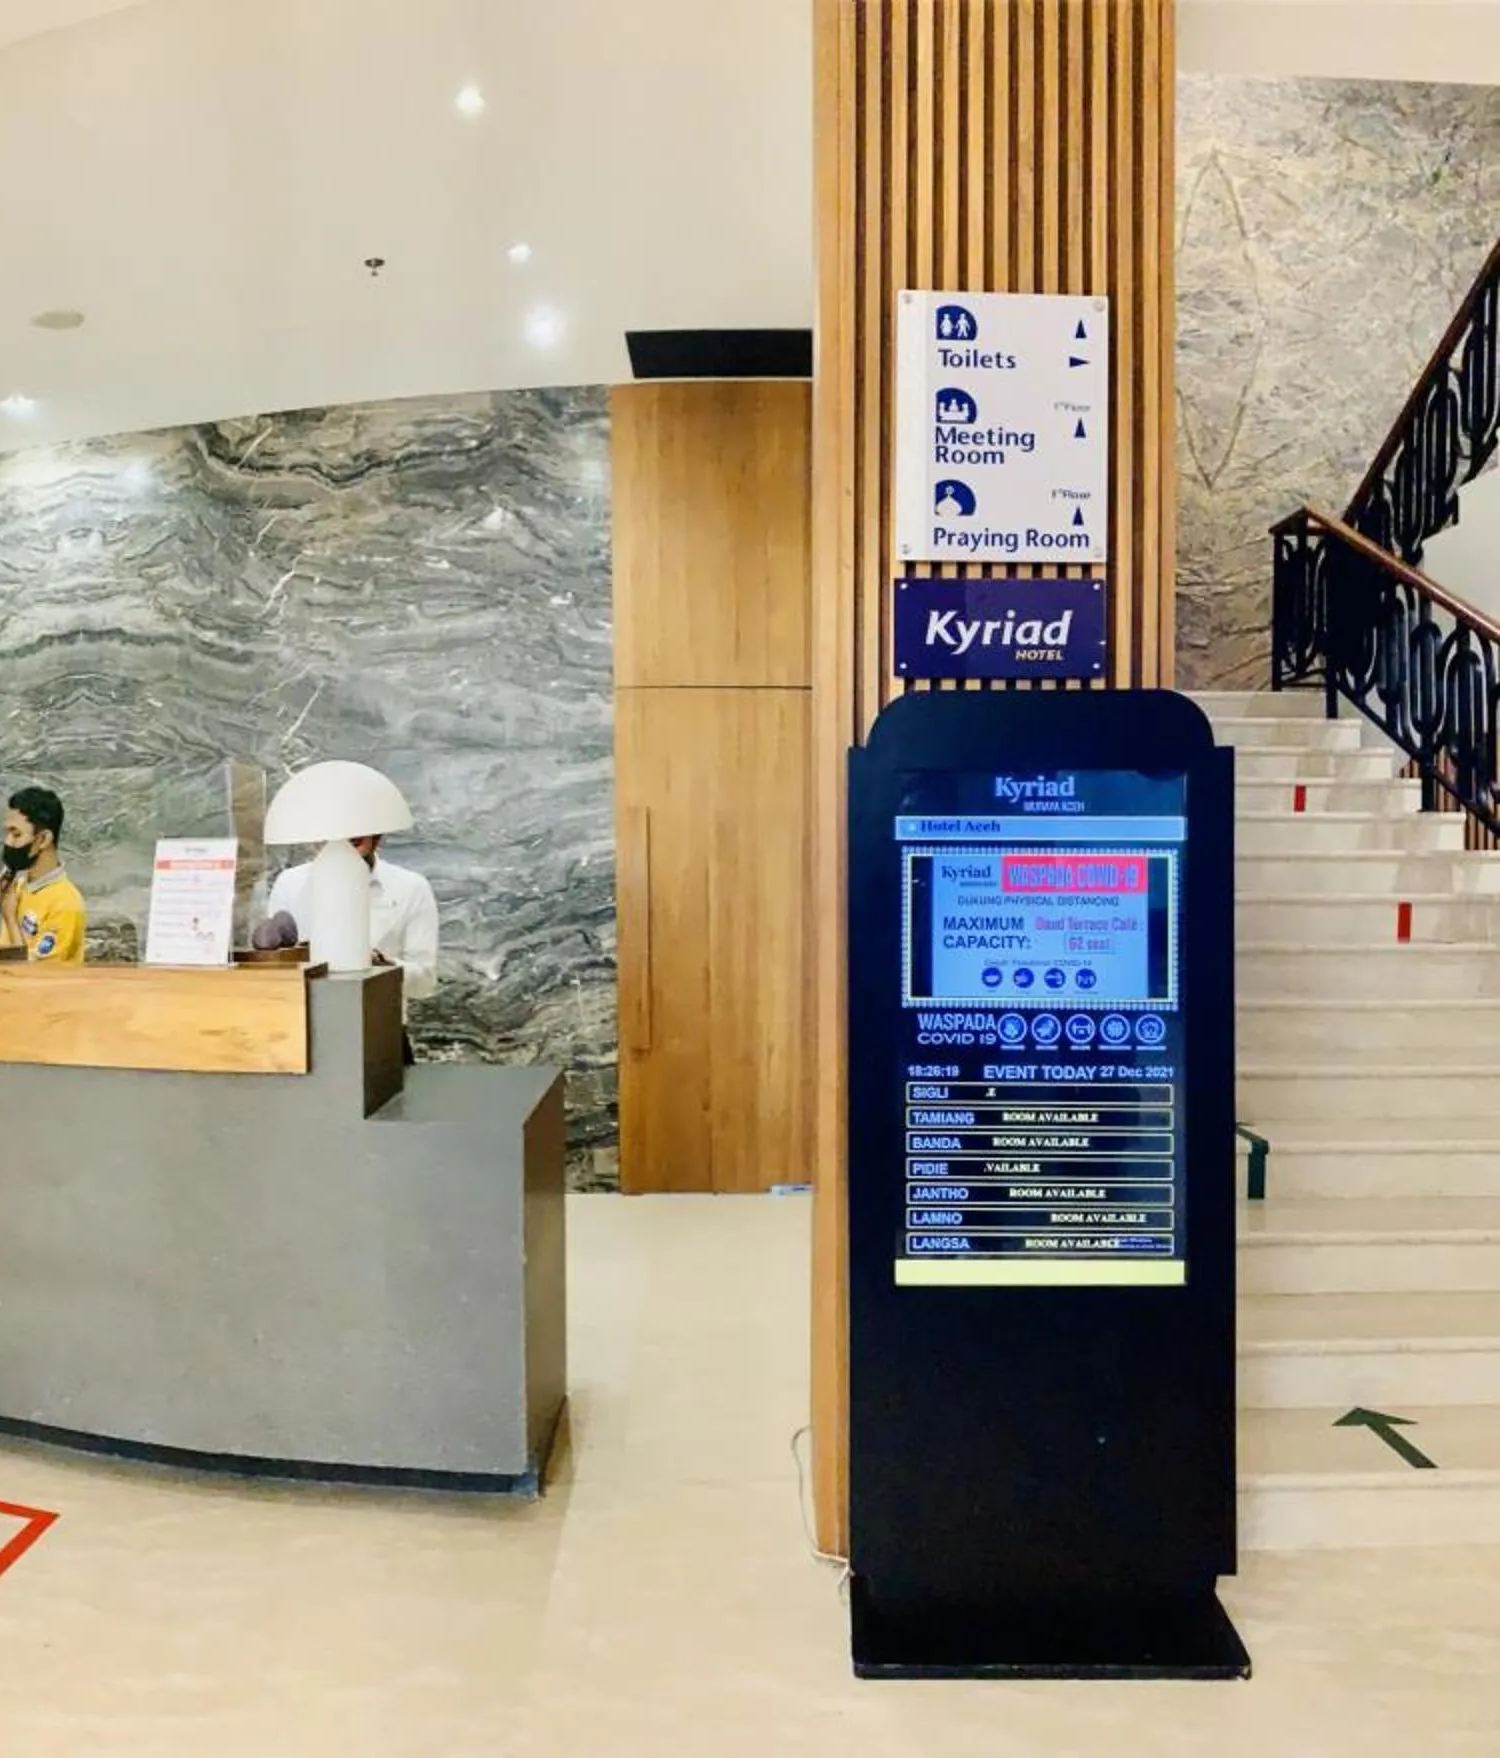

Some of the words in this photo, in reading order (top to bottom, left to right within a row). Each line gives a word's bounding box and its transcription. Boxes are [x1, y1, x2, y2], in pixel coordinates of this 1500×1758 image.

[938, 348, 1017, 369] Toilets
[934, 426, 1036, 452] Meeting
[935, 446, 1005, 465] Room
[933, 527, 1019, 552] Praying
[1025, 528, 1090, 549] Room
[925, 609, 1074, 656] Kyriad
[1015, 648, 1064, 661] HOTEL
[995, 776, 1075, 802] Kyriad
[920, 820, 961, 833] Hotel
[964, 820, 1001, 833] Aceh
[941, 864, 991, 881] Kyriad
[1003, 896, 1054, 907] PHYSICAL
[1057, 896, 1119, 908] DISTANCING
[943, 916, 1024, 931] MAXIMUM
[943, 936, 1032, 950] CAPACITY:
[917, 1013, 996, 1031] WASPADA
[917, 1033, 975, 1045] COVID
[979, 1033, 997, 1045] 19
[983, 1065, 1038, 1079] EVENT
[1041, 1065, 1097, 1079] TODAY
[1100, 1066, 1114, 1077] 27
[1118, 1066, 1142, 1077] Dec
[1145, 1066, 1173, 1078] 2021
[912, 1087, 949, 1099] SIGLI
[912, 1112, 975, 1125] TAMIANG
[1002, 1112, 1036, 1123] ROOM
[1037, 1112, 1099, 1123] AVAILABLE
[912, 1137, 961, 1149] BANDA
[993, 1137, 1026, 1148] ROOM
[1027, 1137, 1089, 1148] AVAILABLE
[912, 1163, 948, 1175] PIDIE
[984, 1162, 1040, 1173] VAILABLE
[912, 1188, 969, 1200] JANTHO
[1009, 1188, 1043, 1198] ROOM
[1044, 1188, 1106, 1199] AVAILABLE
[912, 1212, 963, 1225] LAMNO
[1050, 1212, 1083, 1223] ROOM
[1084, 1212, 1147, 1224] AVAILABLE
[912, 1237, 970, 1249] LANGSA
[1025, 1238, 1059, 1249] ROOM
